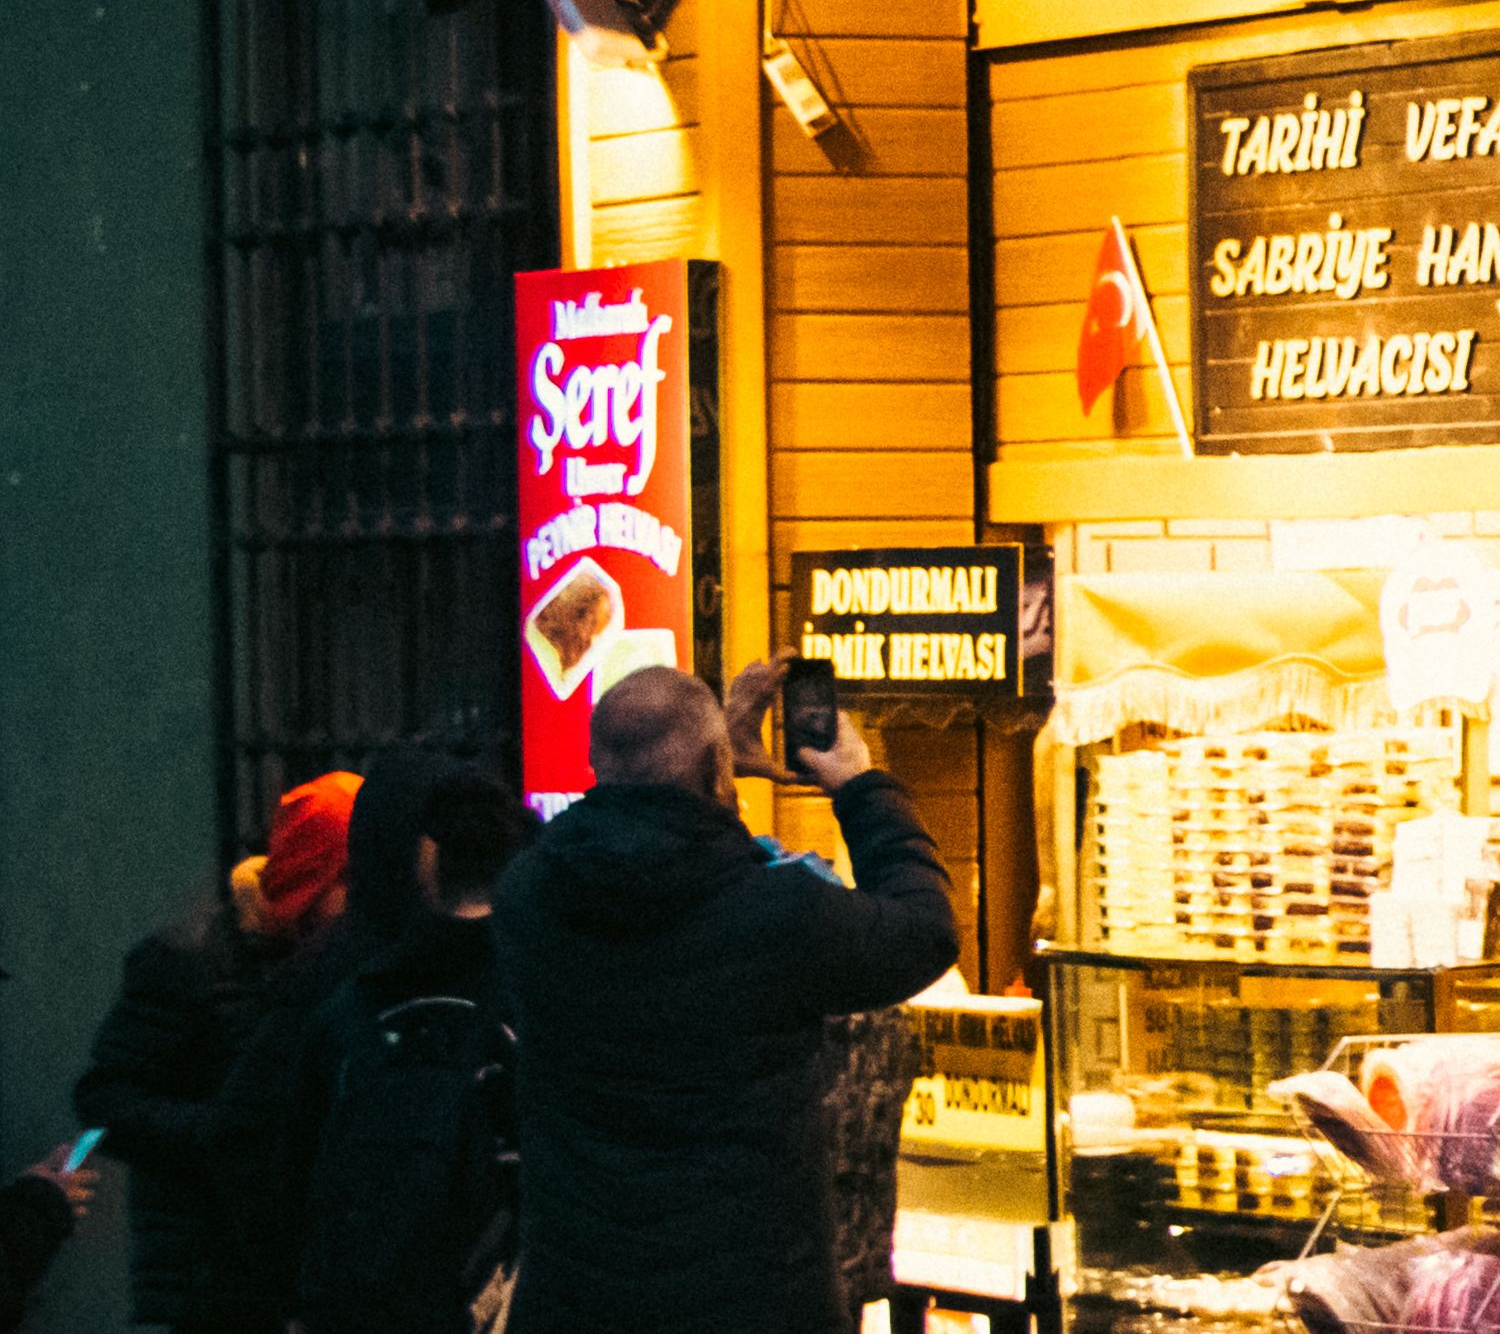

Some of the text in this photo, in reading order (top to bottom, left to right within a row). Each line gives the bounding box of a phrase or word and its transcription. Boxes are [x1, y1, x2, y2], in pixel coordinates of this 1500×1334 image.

[1219, 89, 1368, 175] TARİHİ
[1210, 212, 1395, 300] SABRİYE
[1250, 330, 1477, 401] HELVACISI
[528, 314, 673, 496] Şeref
[810, 565, 999, 616] DONDURMALI
[887, 632, 1007, 681] HELVASI
